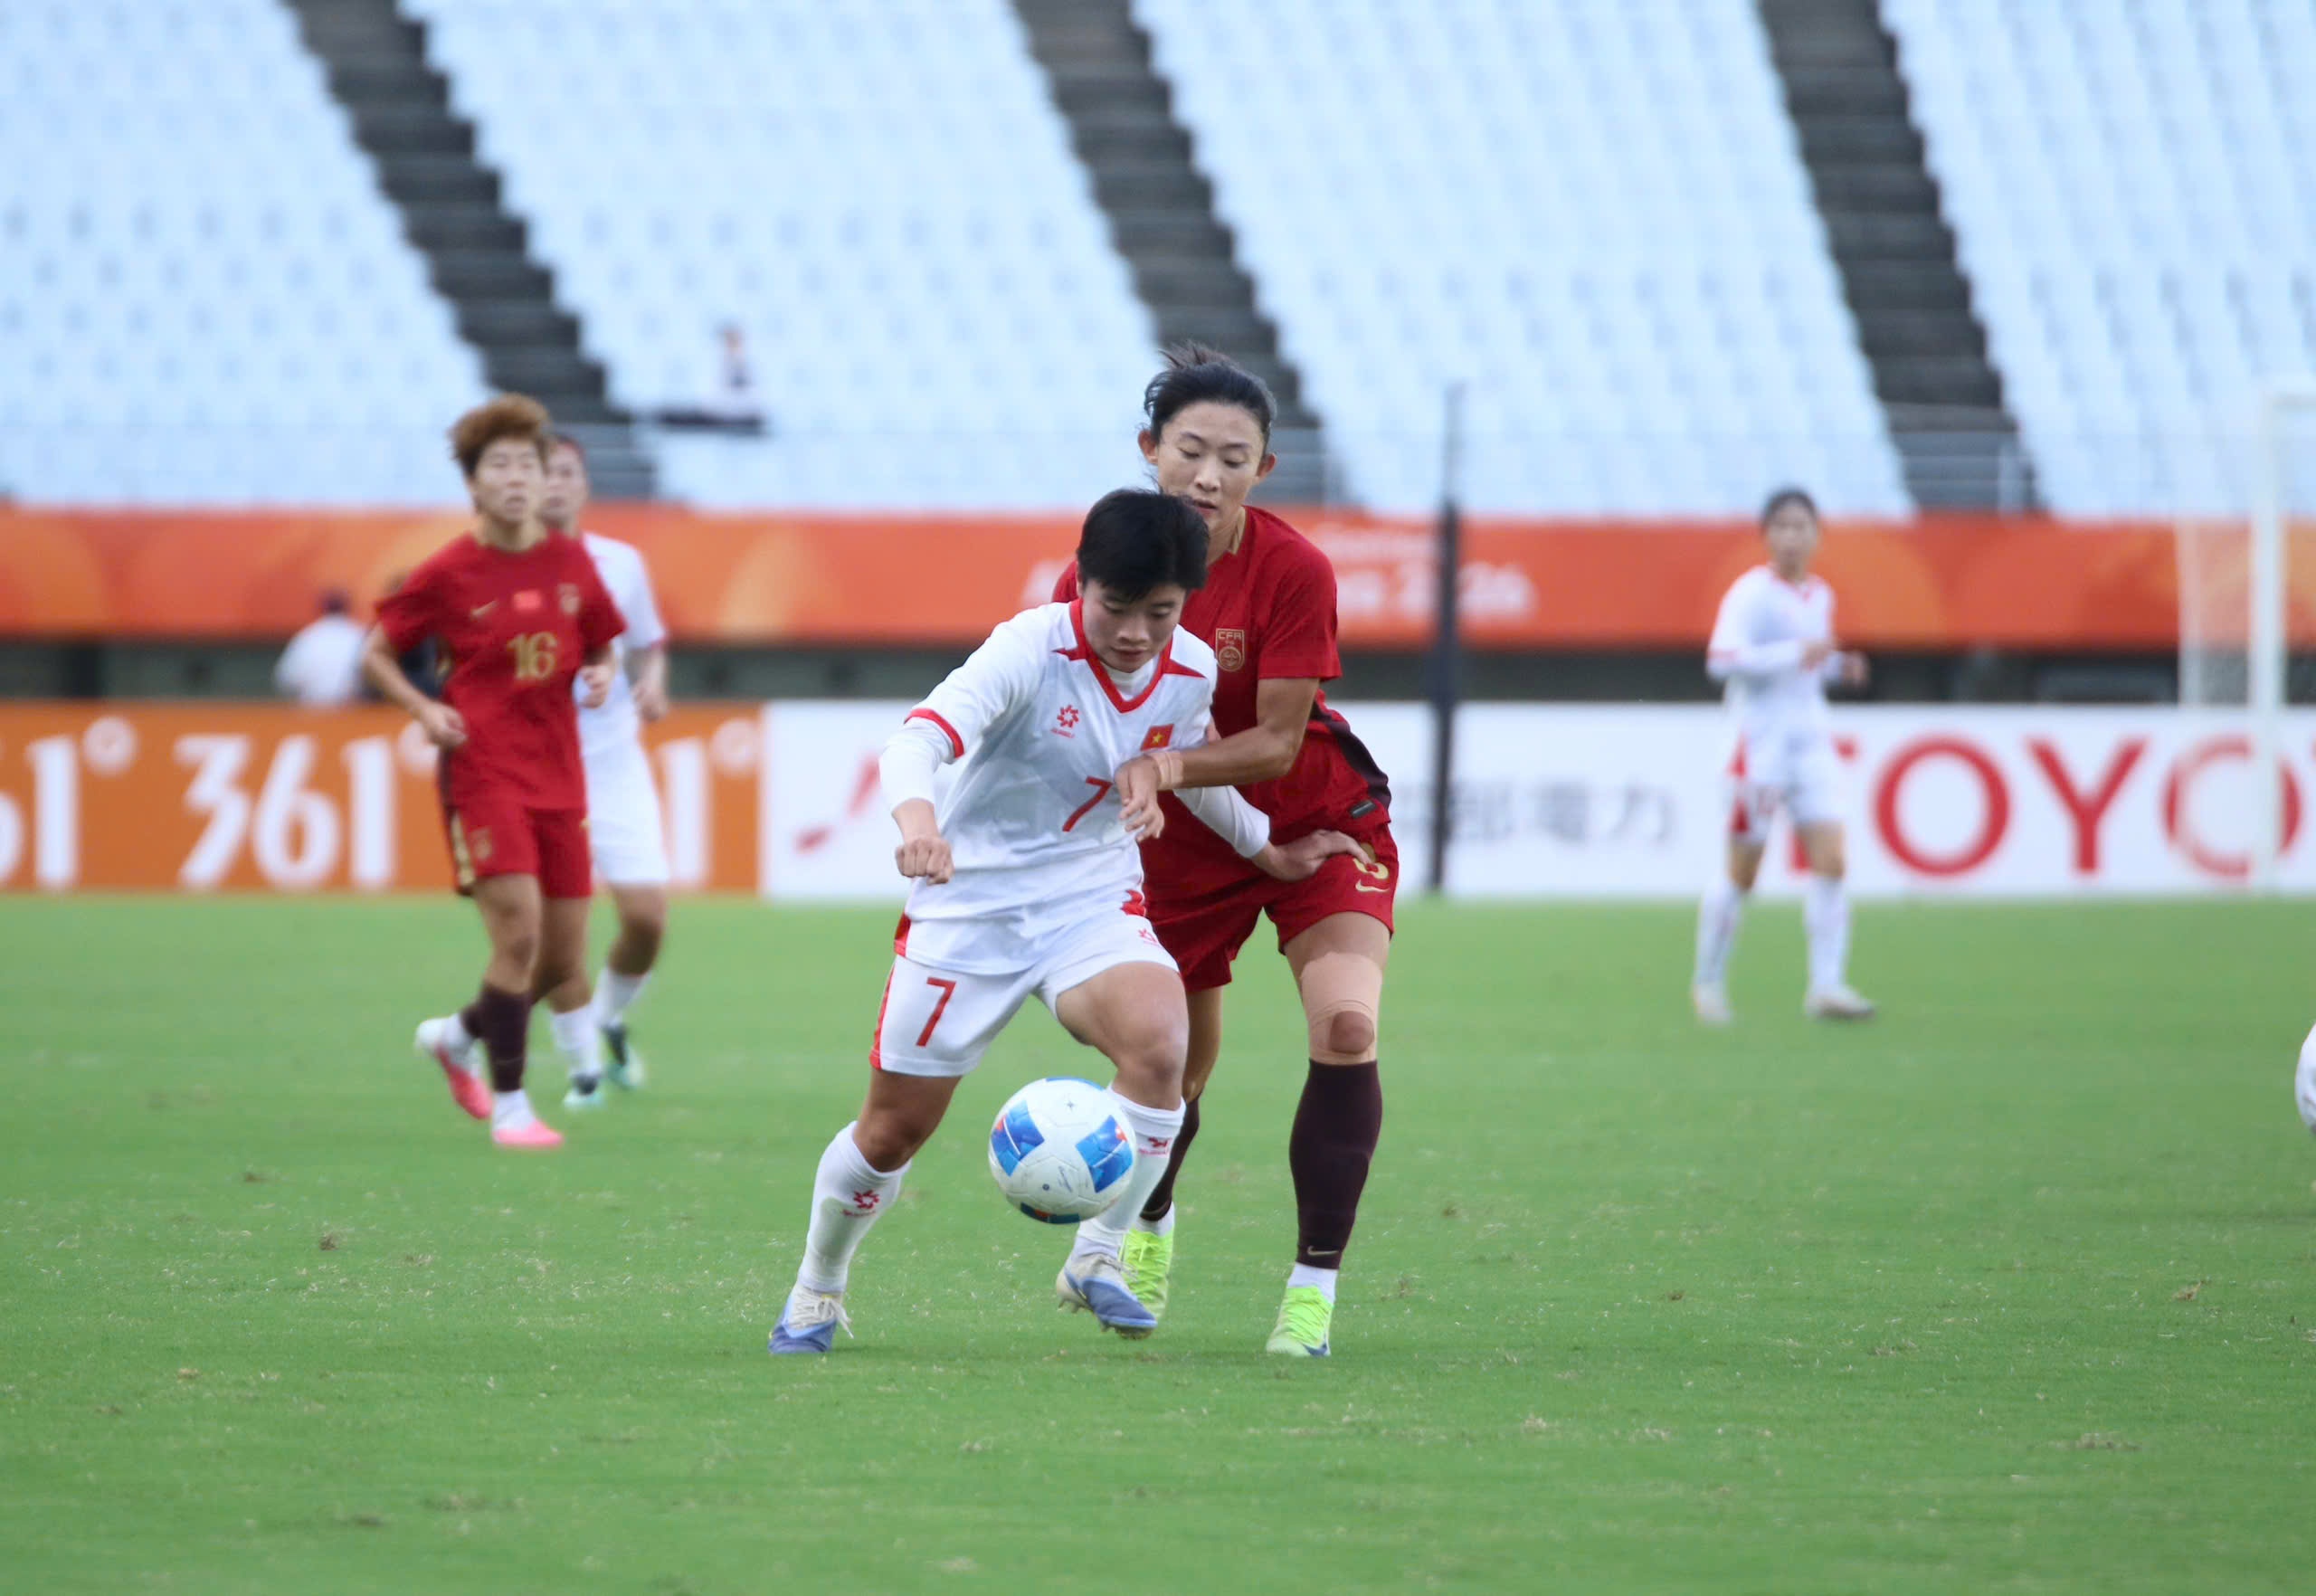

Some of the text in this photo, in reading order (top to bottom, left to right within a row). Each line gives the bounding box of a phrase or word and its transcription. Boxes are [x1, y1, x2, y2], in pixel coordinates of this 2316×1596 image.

[507, 632, 558, 680] 16
[1218, 631, 1242, 641] CFA
[1062, 775, 1114, 832] 7
[915, 976, 956, 1048] 7
